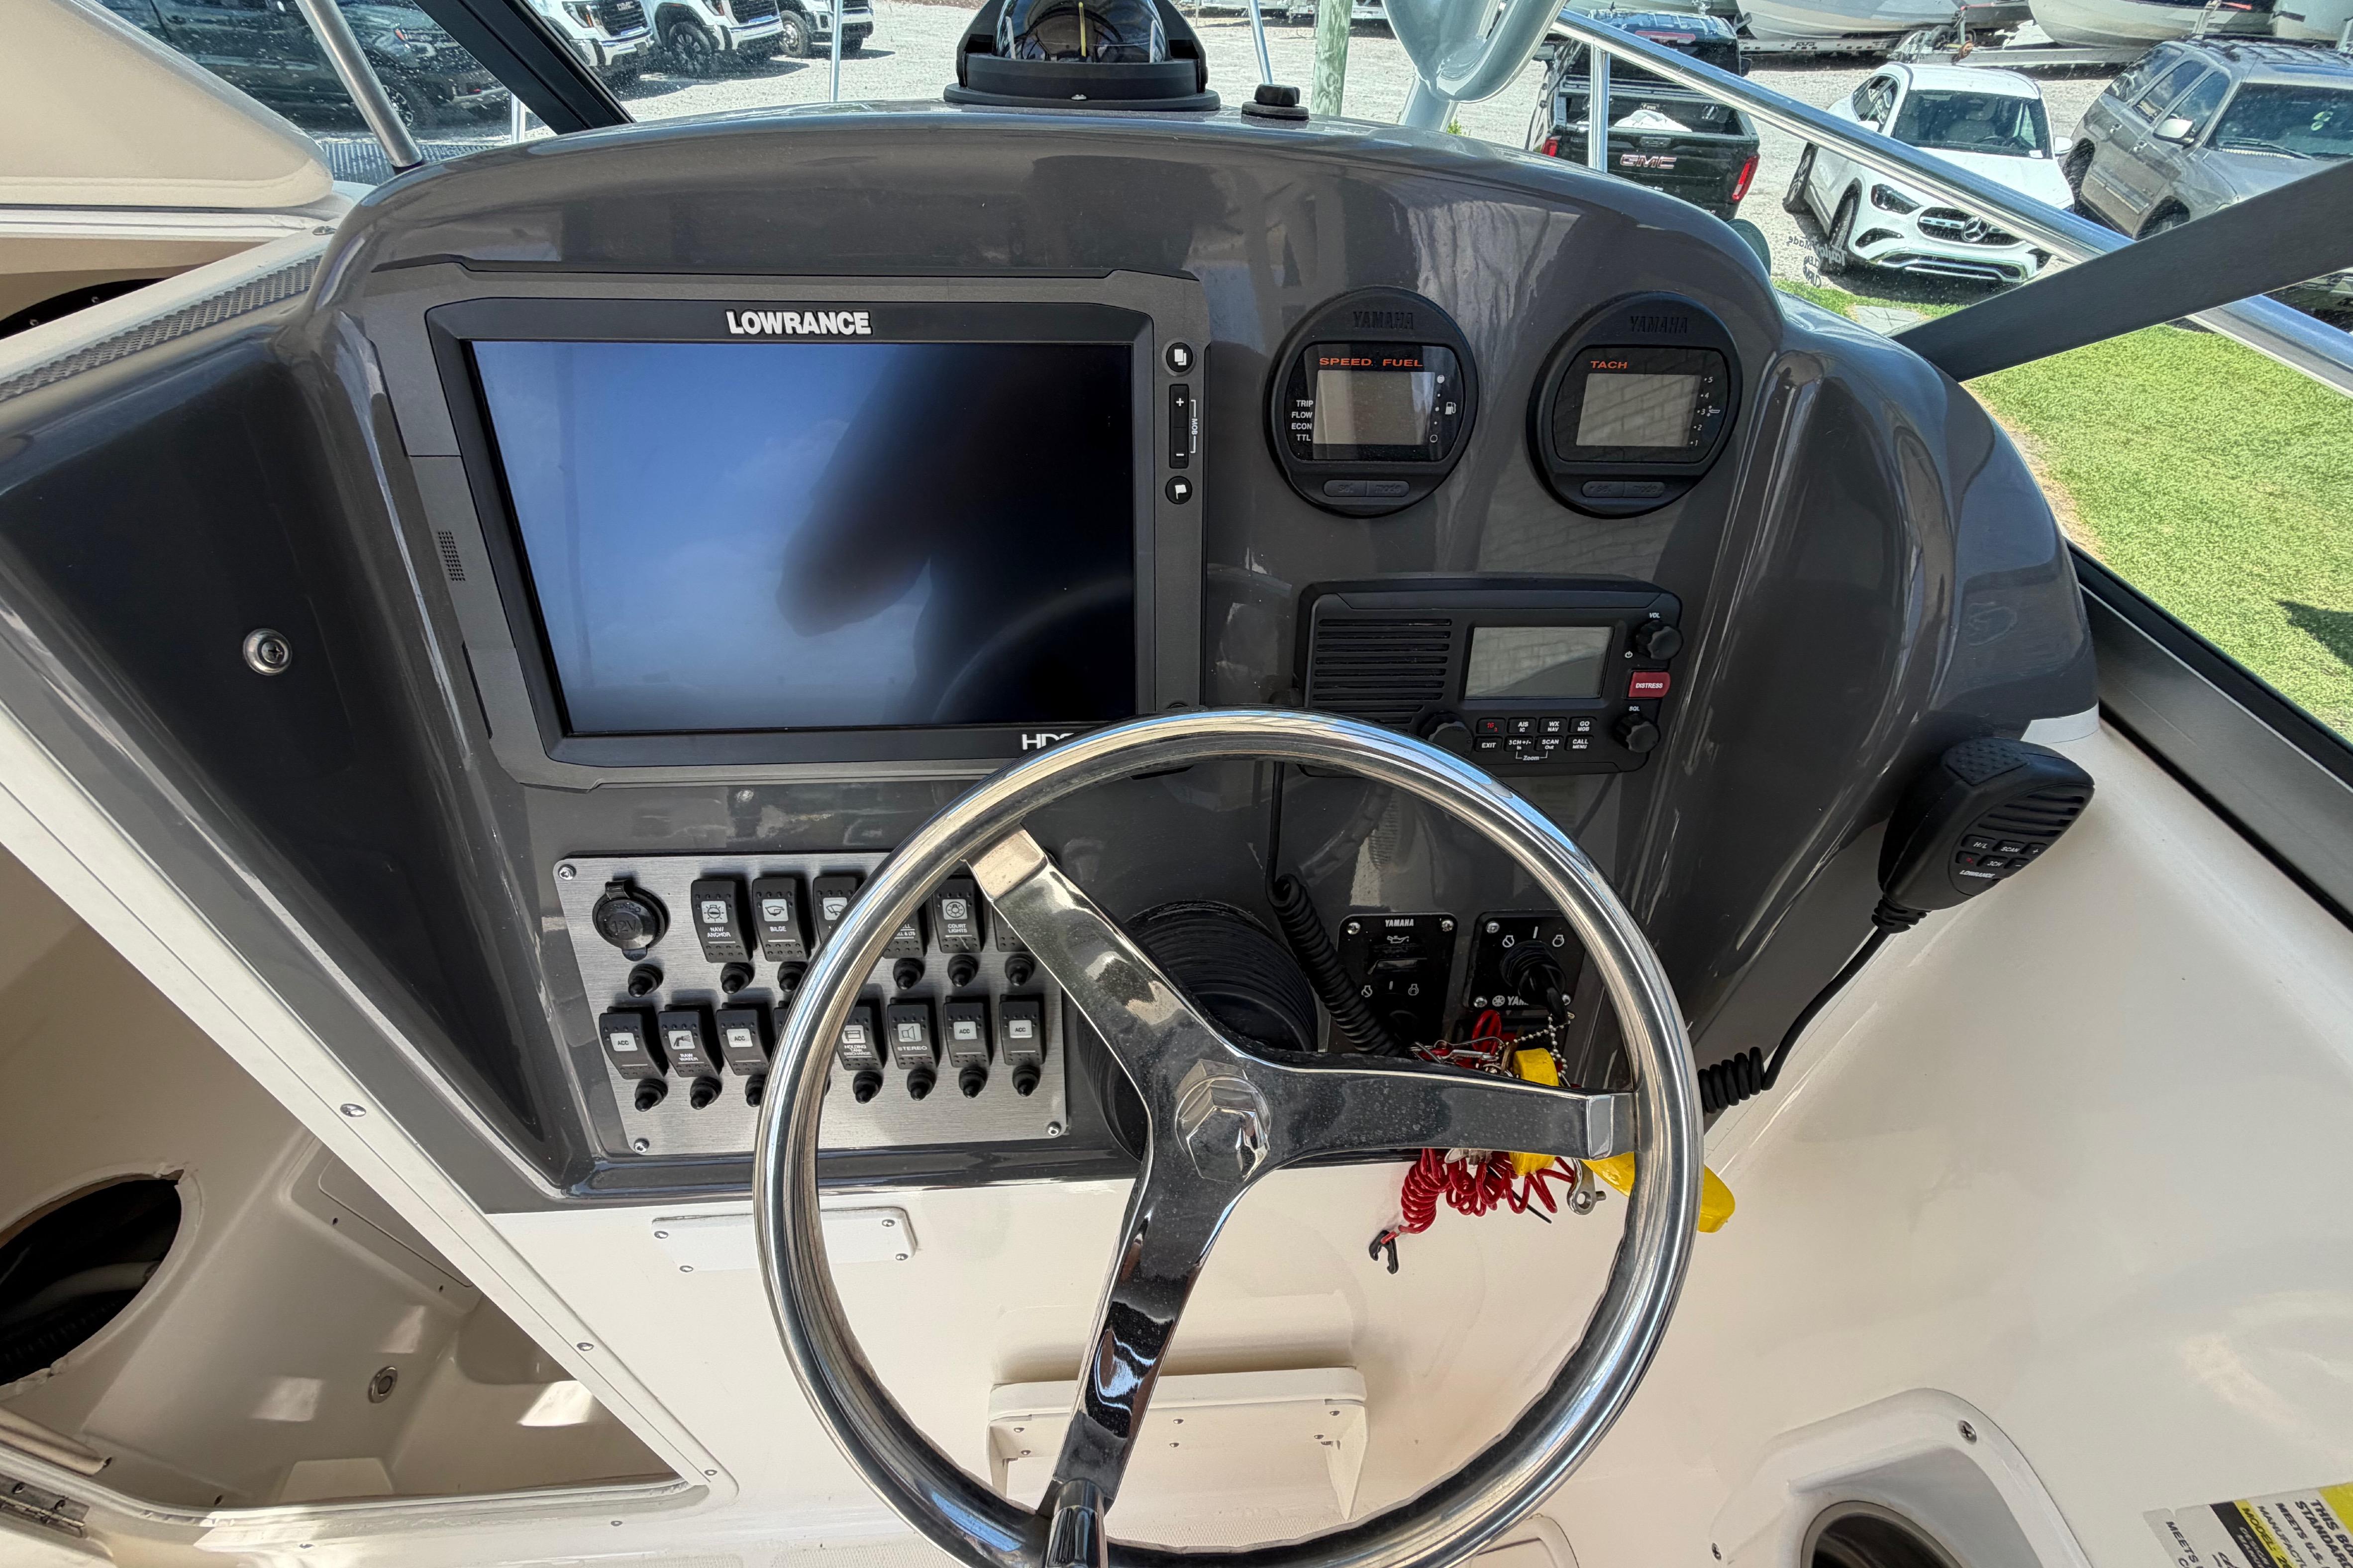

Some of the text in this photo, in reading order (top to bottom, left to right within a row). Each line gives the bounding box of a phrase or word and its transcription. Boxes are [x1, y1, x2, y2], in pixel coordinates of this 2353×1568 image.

[1620, 154, 1677, 169] GMC
[725, 309, 872, 336] LOWRANCE
[1352, 311, 1414, 330] YAMAHA
[1630, 315, 1688, 334] YAMAHA
[1319, 358, 1424, 367] SPEED FUEL
[1591, 360, 1628, 370] TACH
[1022, 733, 1075, 750] HD
[1959, 870, 1996, 879] LOWRANCE
[613, 919, 637, 933] 12V
[1385, 919, 1414, 927] YAMAHA
[2310, 1499, 2340, 1531] THIS
[2165, 1521, 2199, 1563] MEETS
[2275, 1502, 2324, 1565] MEETS U.S.
